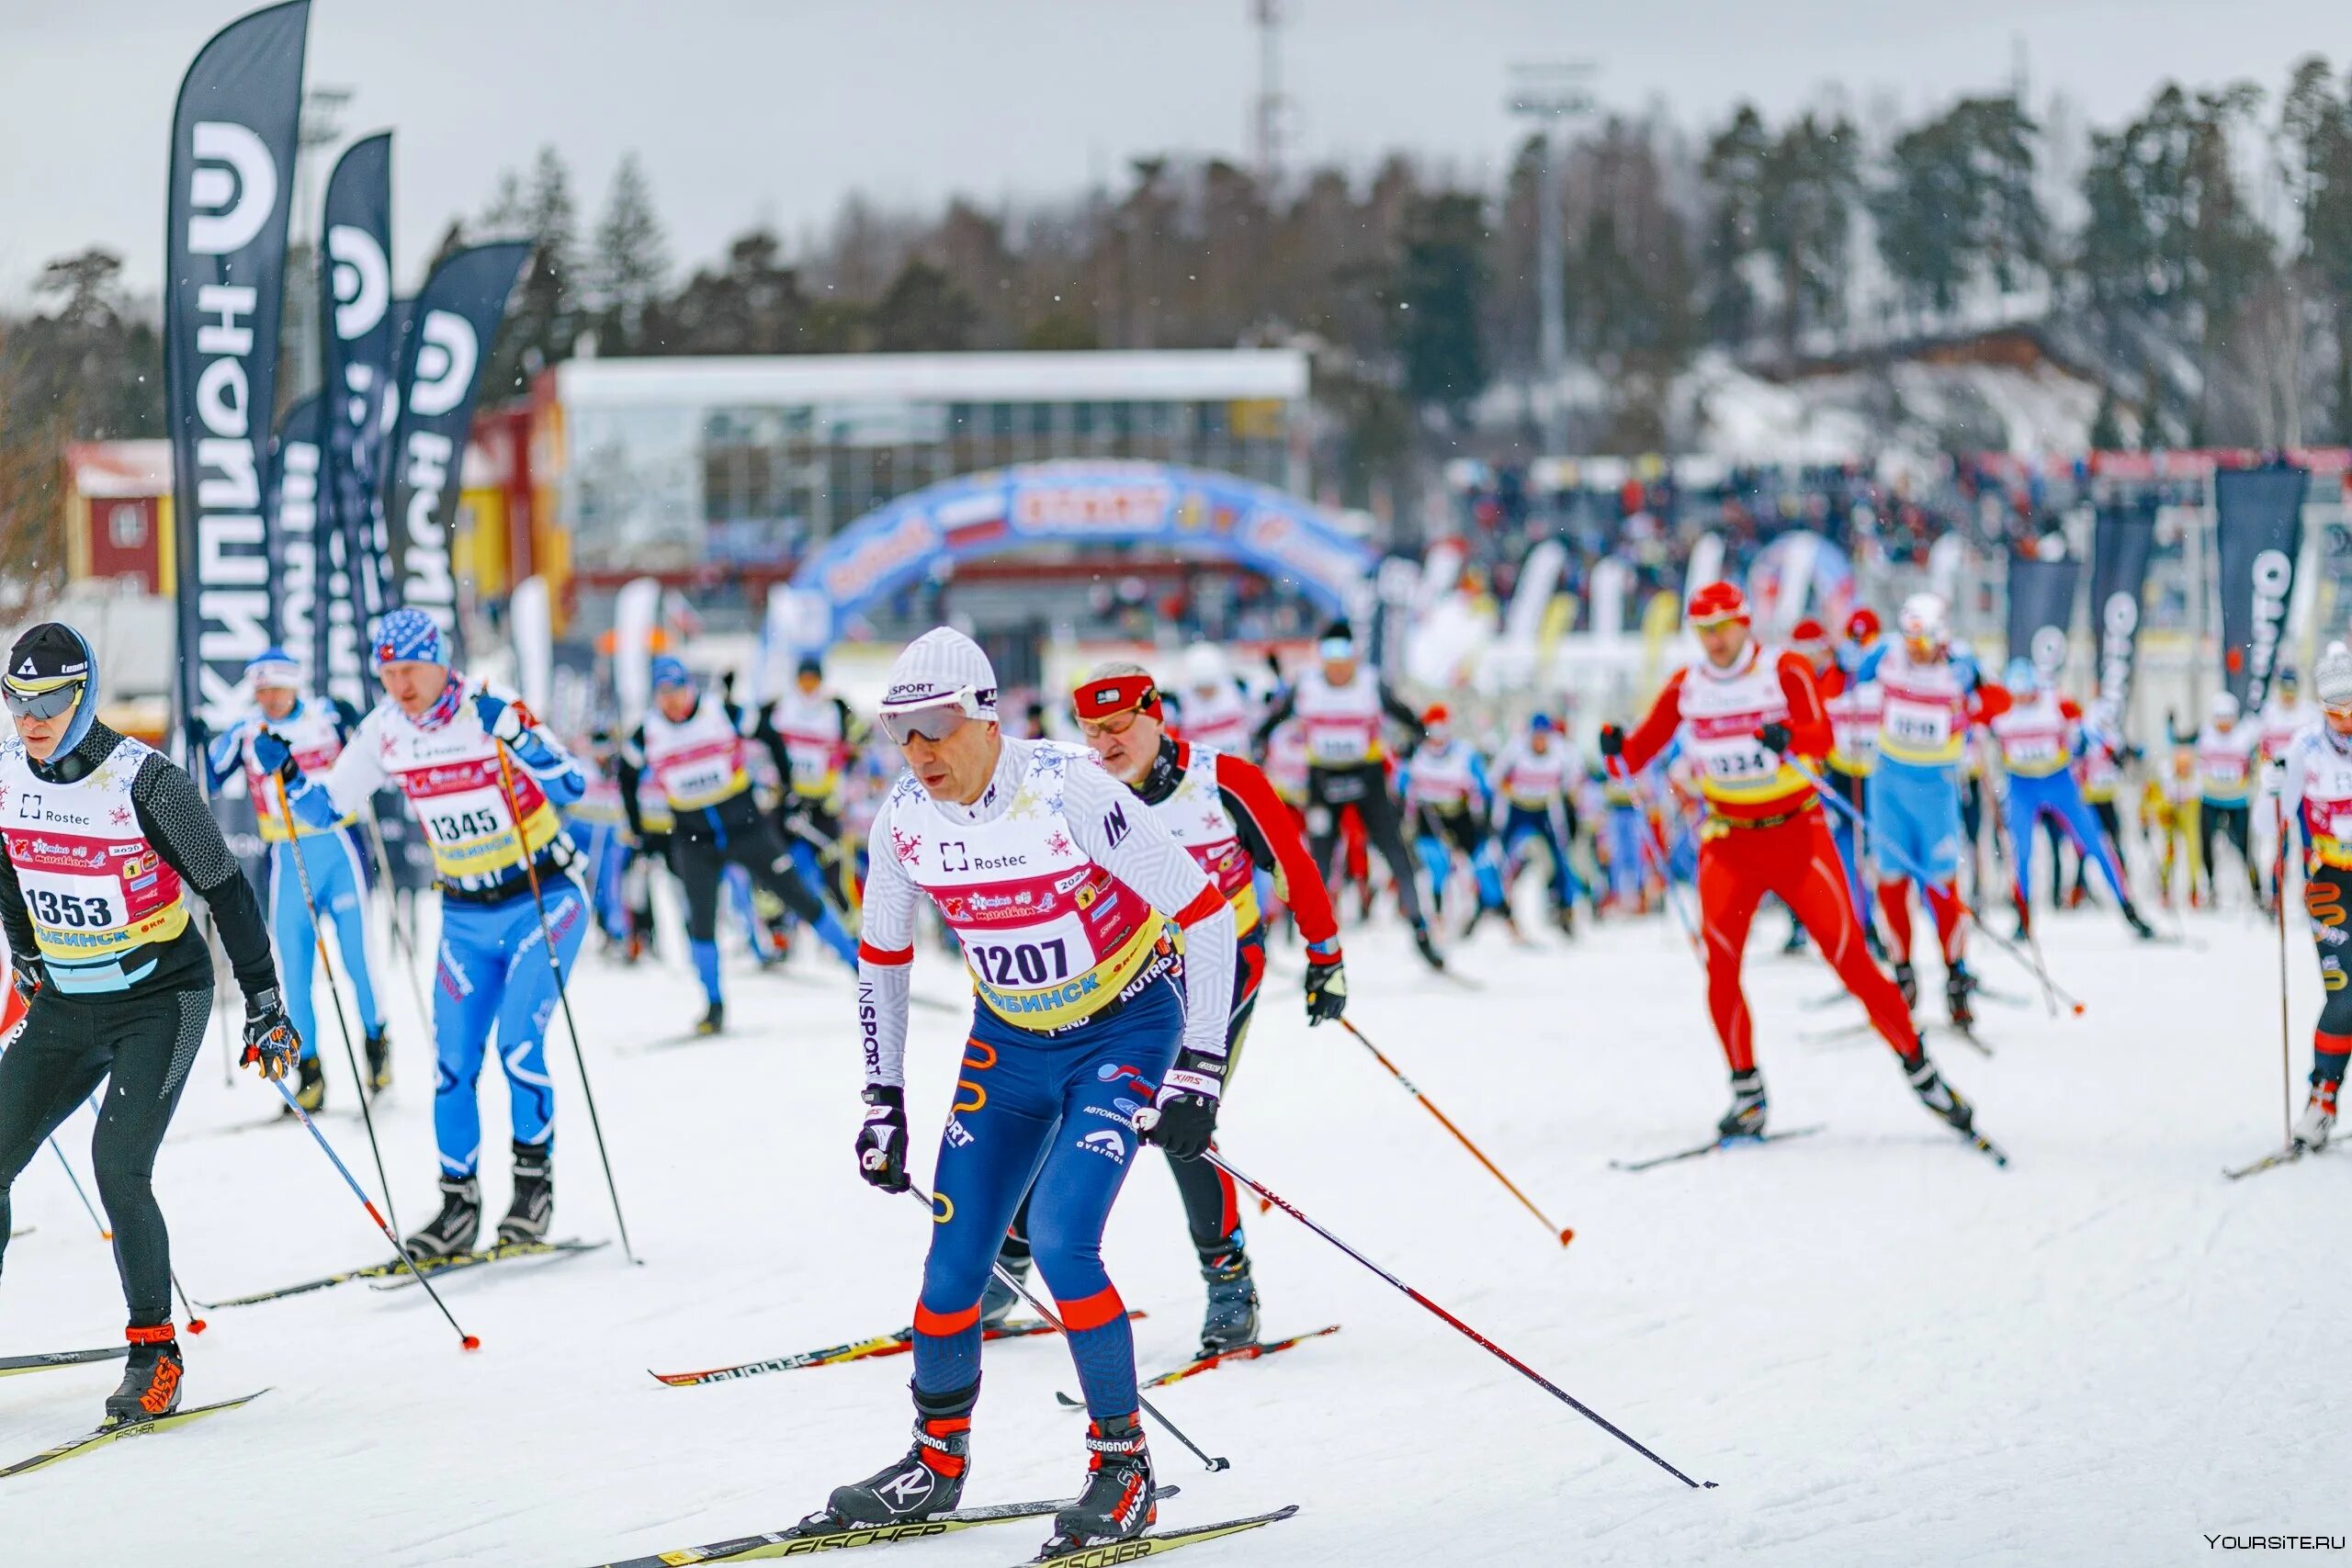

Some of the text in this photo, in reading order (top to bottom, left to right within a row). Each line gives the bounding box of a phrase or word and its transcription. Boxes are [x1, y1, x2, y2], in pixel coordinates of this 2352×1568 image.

[46, 810, 90, 826] Rostec
[431, 808, 498, 841] 1345
[1103, 801, 1127, 848] IN
[35, 854, 87, 867] marathon
[975, 853, 1026, 871] Rostec
[26, 888, 112, 928] 1353
[977, 907, 1035, 920] marathon
[972, 938, 1069, 986] 1207
[978, 972, 1102, 1013] РЫБИНСК
[858, 982, 882, 1076] INSPORT
[115, 1422, 155, 1441] FISCHER
[783, 1523, 947, 1557] FISCHER
